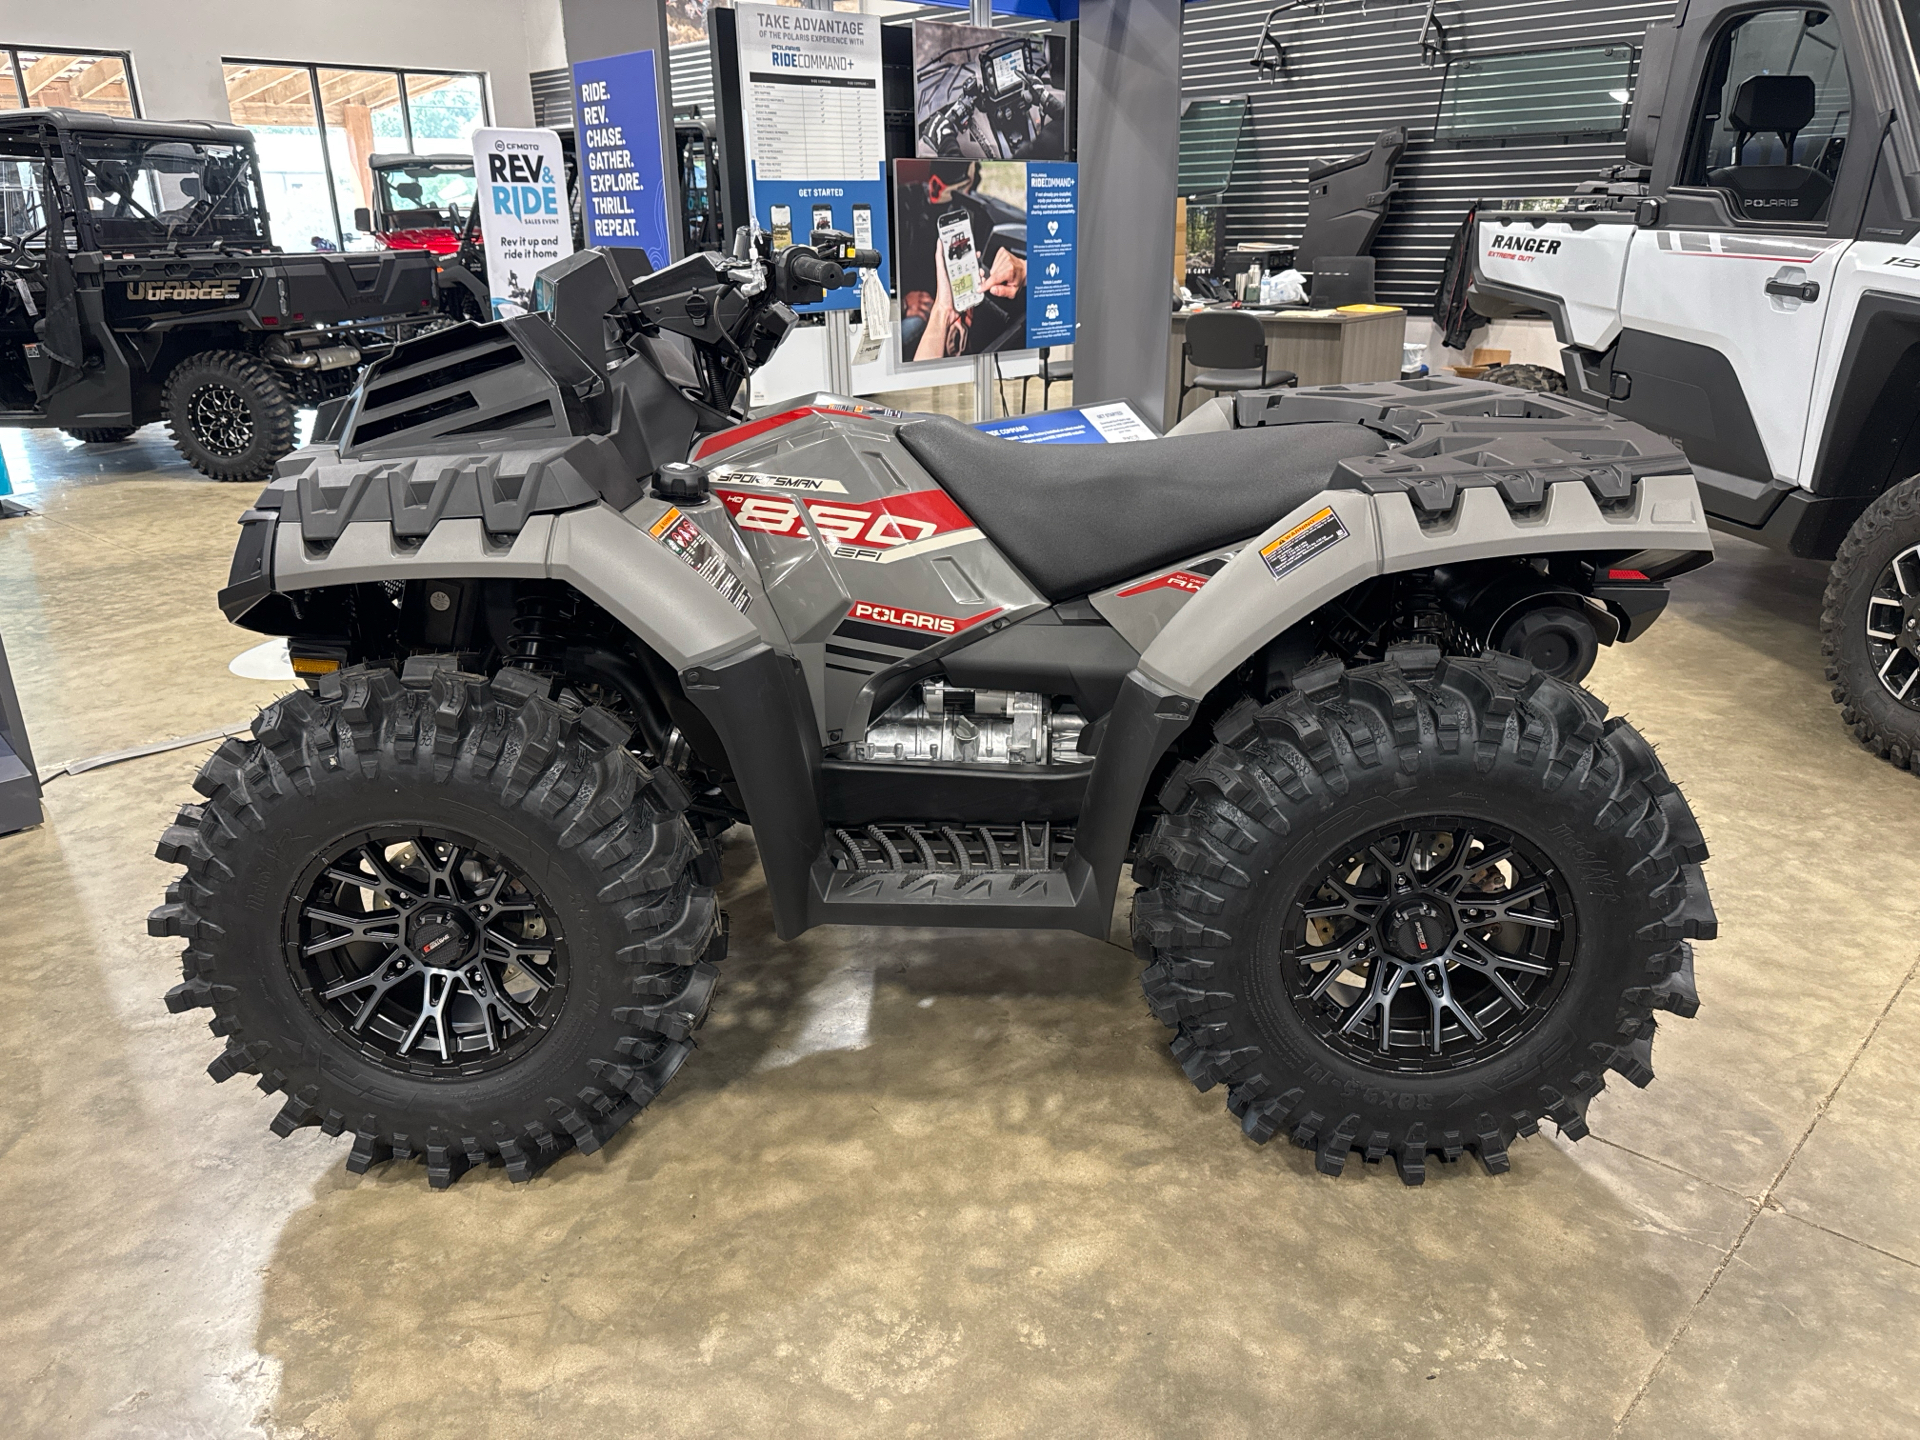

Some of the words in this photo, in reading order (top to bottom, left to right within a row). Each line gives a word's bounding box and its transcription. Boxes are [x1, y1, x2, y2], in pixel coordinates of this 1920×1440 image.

[757, 13, 790, 29] TAKE
[794, 17, 864, 35] ADVANTAGE
[759, 30, 766, 38] OF
[769, 31, 782, 39] THE
[783, 34, 810, 42] POLARIS
[811, 36, 848, 45] EXPERIENCE
[582, 82, 610, 102] RIDE.
[584, 105, 609, 125] REV.
[586, 127, 626, 148] CHASE.
[588, 150, 634, 170] GATHER.
[590, 172, 644, 192] EXPLORE.
[799, 189, 811, 197] GET
[814, 188, 844, 197] STARTED
[492, 186, 558, 224] RIDE
[592, 196, 634, 214] THRILL.
[1744, 199, 1798, 207] POLARIS
[595, 219, 639, 236] REPEAT.
[501, 237, 517, 247] Rev
[520, 236, 527, 246] it
[528, 238, 539, 248] up
[541, 236, 558, 246] and
[1492, 235, 1561, 254] RANGER
[504, 250, 522, 259] ride
[525, 250, 532, 259] it
[533, 249, 558, 258] home
[1488, 250, 1516, 260] EXTREME
[148, 288, 224, 300] UFORCE
[1000, 425, 1029, 435] COMMAND
[718, 474, 824, 490] SPORTSMAN
[735, 497, 938, 544] 850
[1285, 519, 1315, 540] WARNING
[834, 547, 882, 562] EFI
[856, 604, 955, 632] POLARIS
